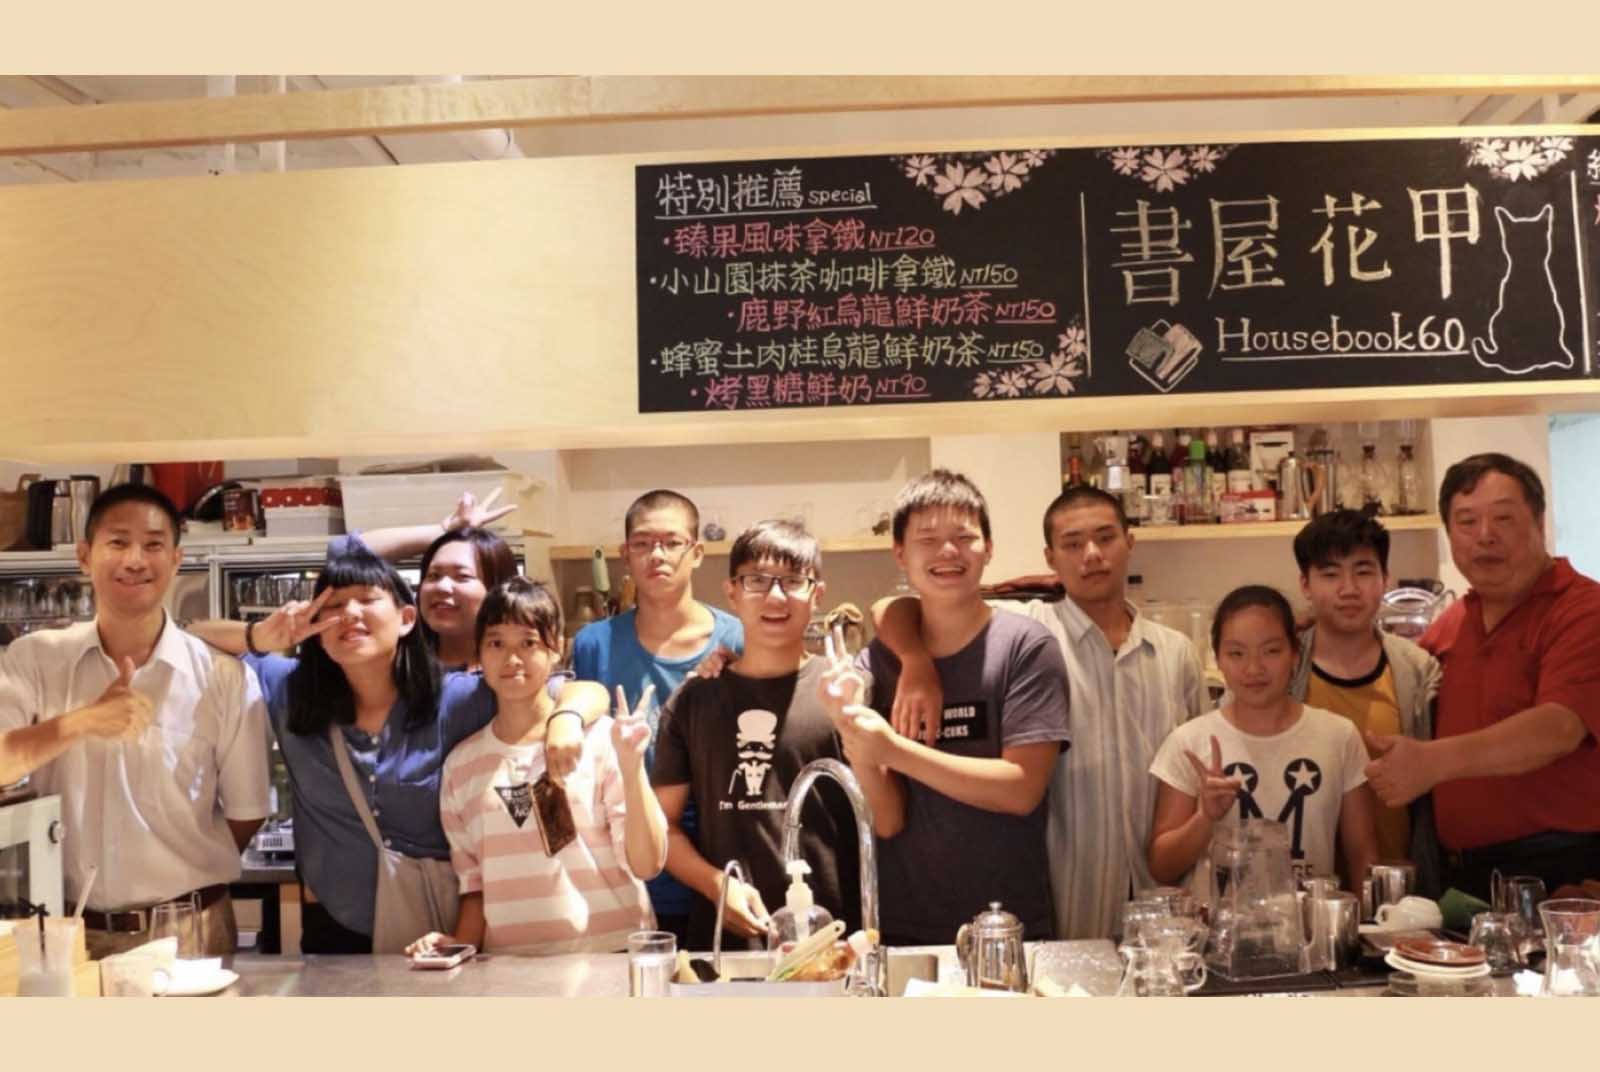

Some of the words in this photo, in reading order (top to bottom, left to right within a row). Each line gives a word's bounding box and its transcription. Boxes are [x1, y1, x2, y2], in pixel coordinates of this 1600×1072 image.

[655, 165, 804, 216] 特別推薦
[807, 182, 872, 206] special
[869, 225, 936, 248] NT120
[1109, 182, 1480, 306] 書屋花甲
[960, 263, 1019, 285] NT150
[735, 290, 993, 333] 鹿野紅烏龍鮮奶茶
[995, 298, 1057, 320] NT150
[987, 338, 1045, 360] NT150
[1216, 312, 1465, 353] Housebook60
[703, 372, 873, 411] 烤黑糖鮮奶
